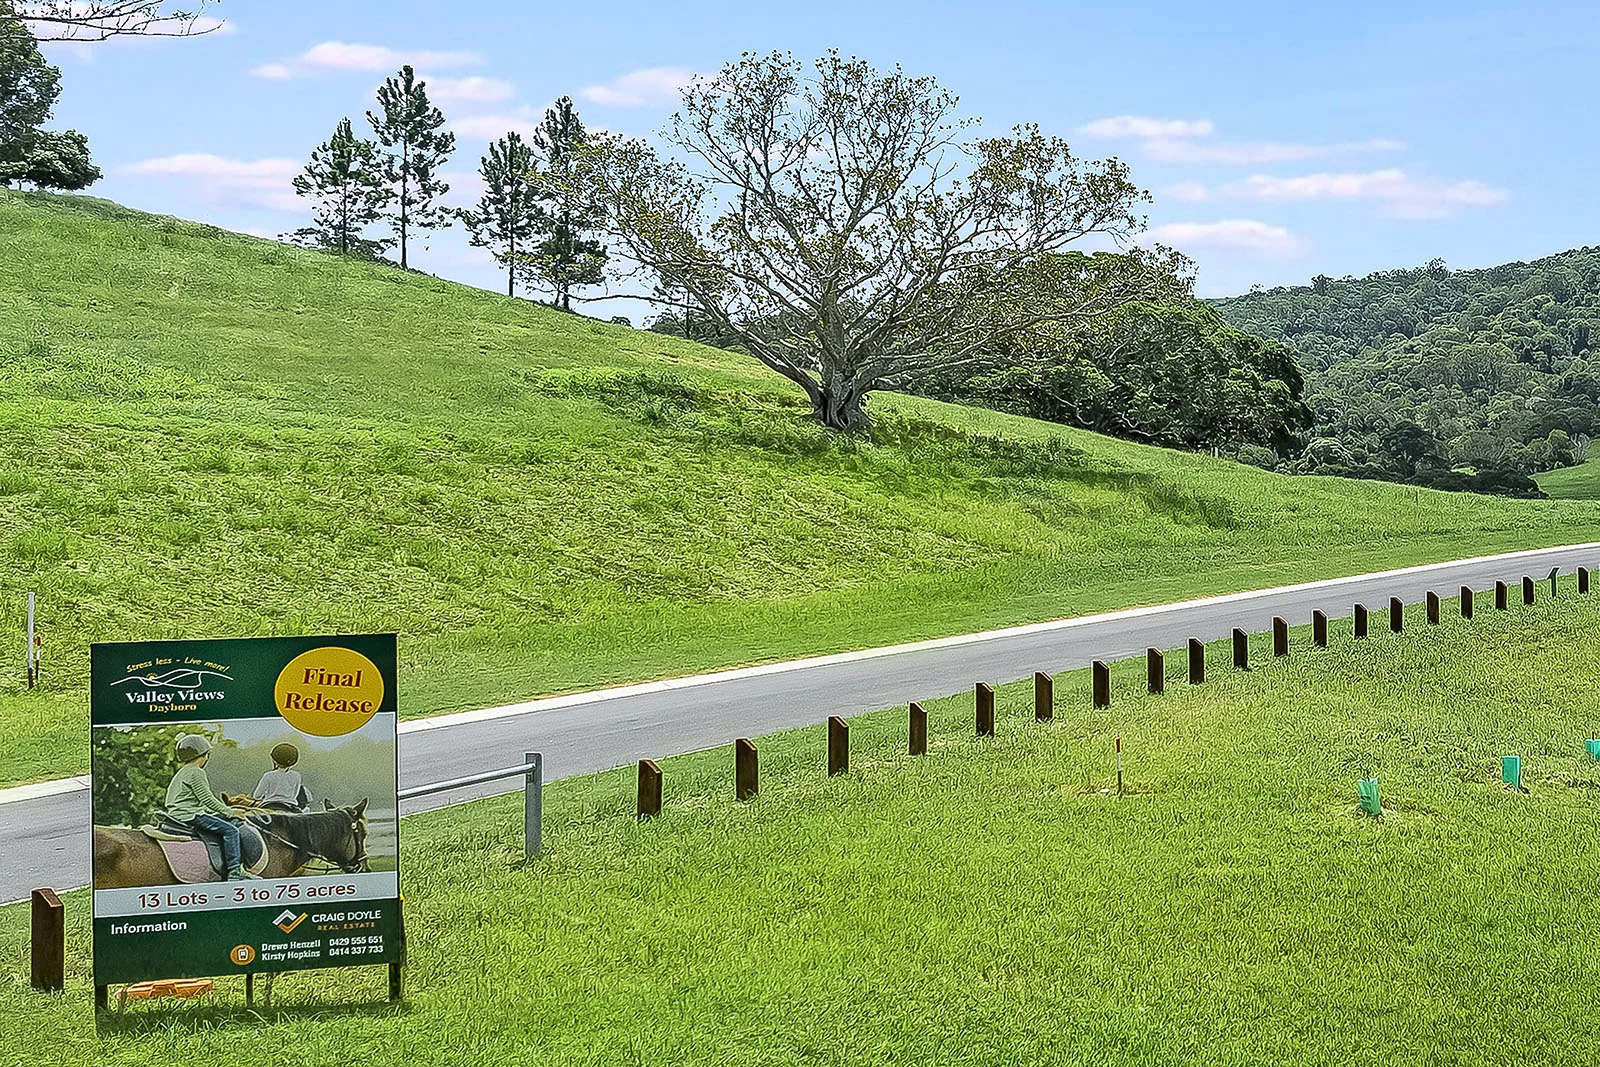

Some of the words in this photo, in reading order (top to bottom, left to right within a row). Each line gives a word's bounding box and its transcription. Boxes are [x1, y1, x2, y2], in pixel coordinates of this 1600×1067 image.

[126, 660, 153, 673] Stress
[155, 657, 172, 665] less
[184, 656, 202, 665] Live
[204, 660, 230, 673] more!
[302, 667, 363, 687] Final
[125, 690, 175, 704] Valley
[177, 689, 225, 701] Views
[284, 692, 373, 714] Release
[148, 703, 197, 714] Dayboro
[138, 893, 160, 909] 13
[167, 892, 208, 907] Lots
[232, 887, 246, 902] 3
[251, 888, 270, 901] to
[275, 884, 301, 900] 75
[306, 884, 356, 898] acres
[311, 912, 345, 923] CRAIG
[347, 909, 382, 920] DOYLE
[110, 920, 187, 935] Information
[343, 922, 376, 930] ESTATE
[329, 937, 350, 946] 0429
[351, 936, 367, 945] 555
[261, 952, 286, 961] Kirsty
[287, 950, 321, 960] Hopkins
[329, 947, 350, 956] 0414
[351, 946, 366, 955] 337
[368, 945, 384, 954] 733
